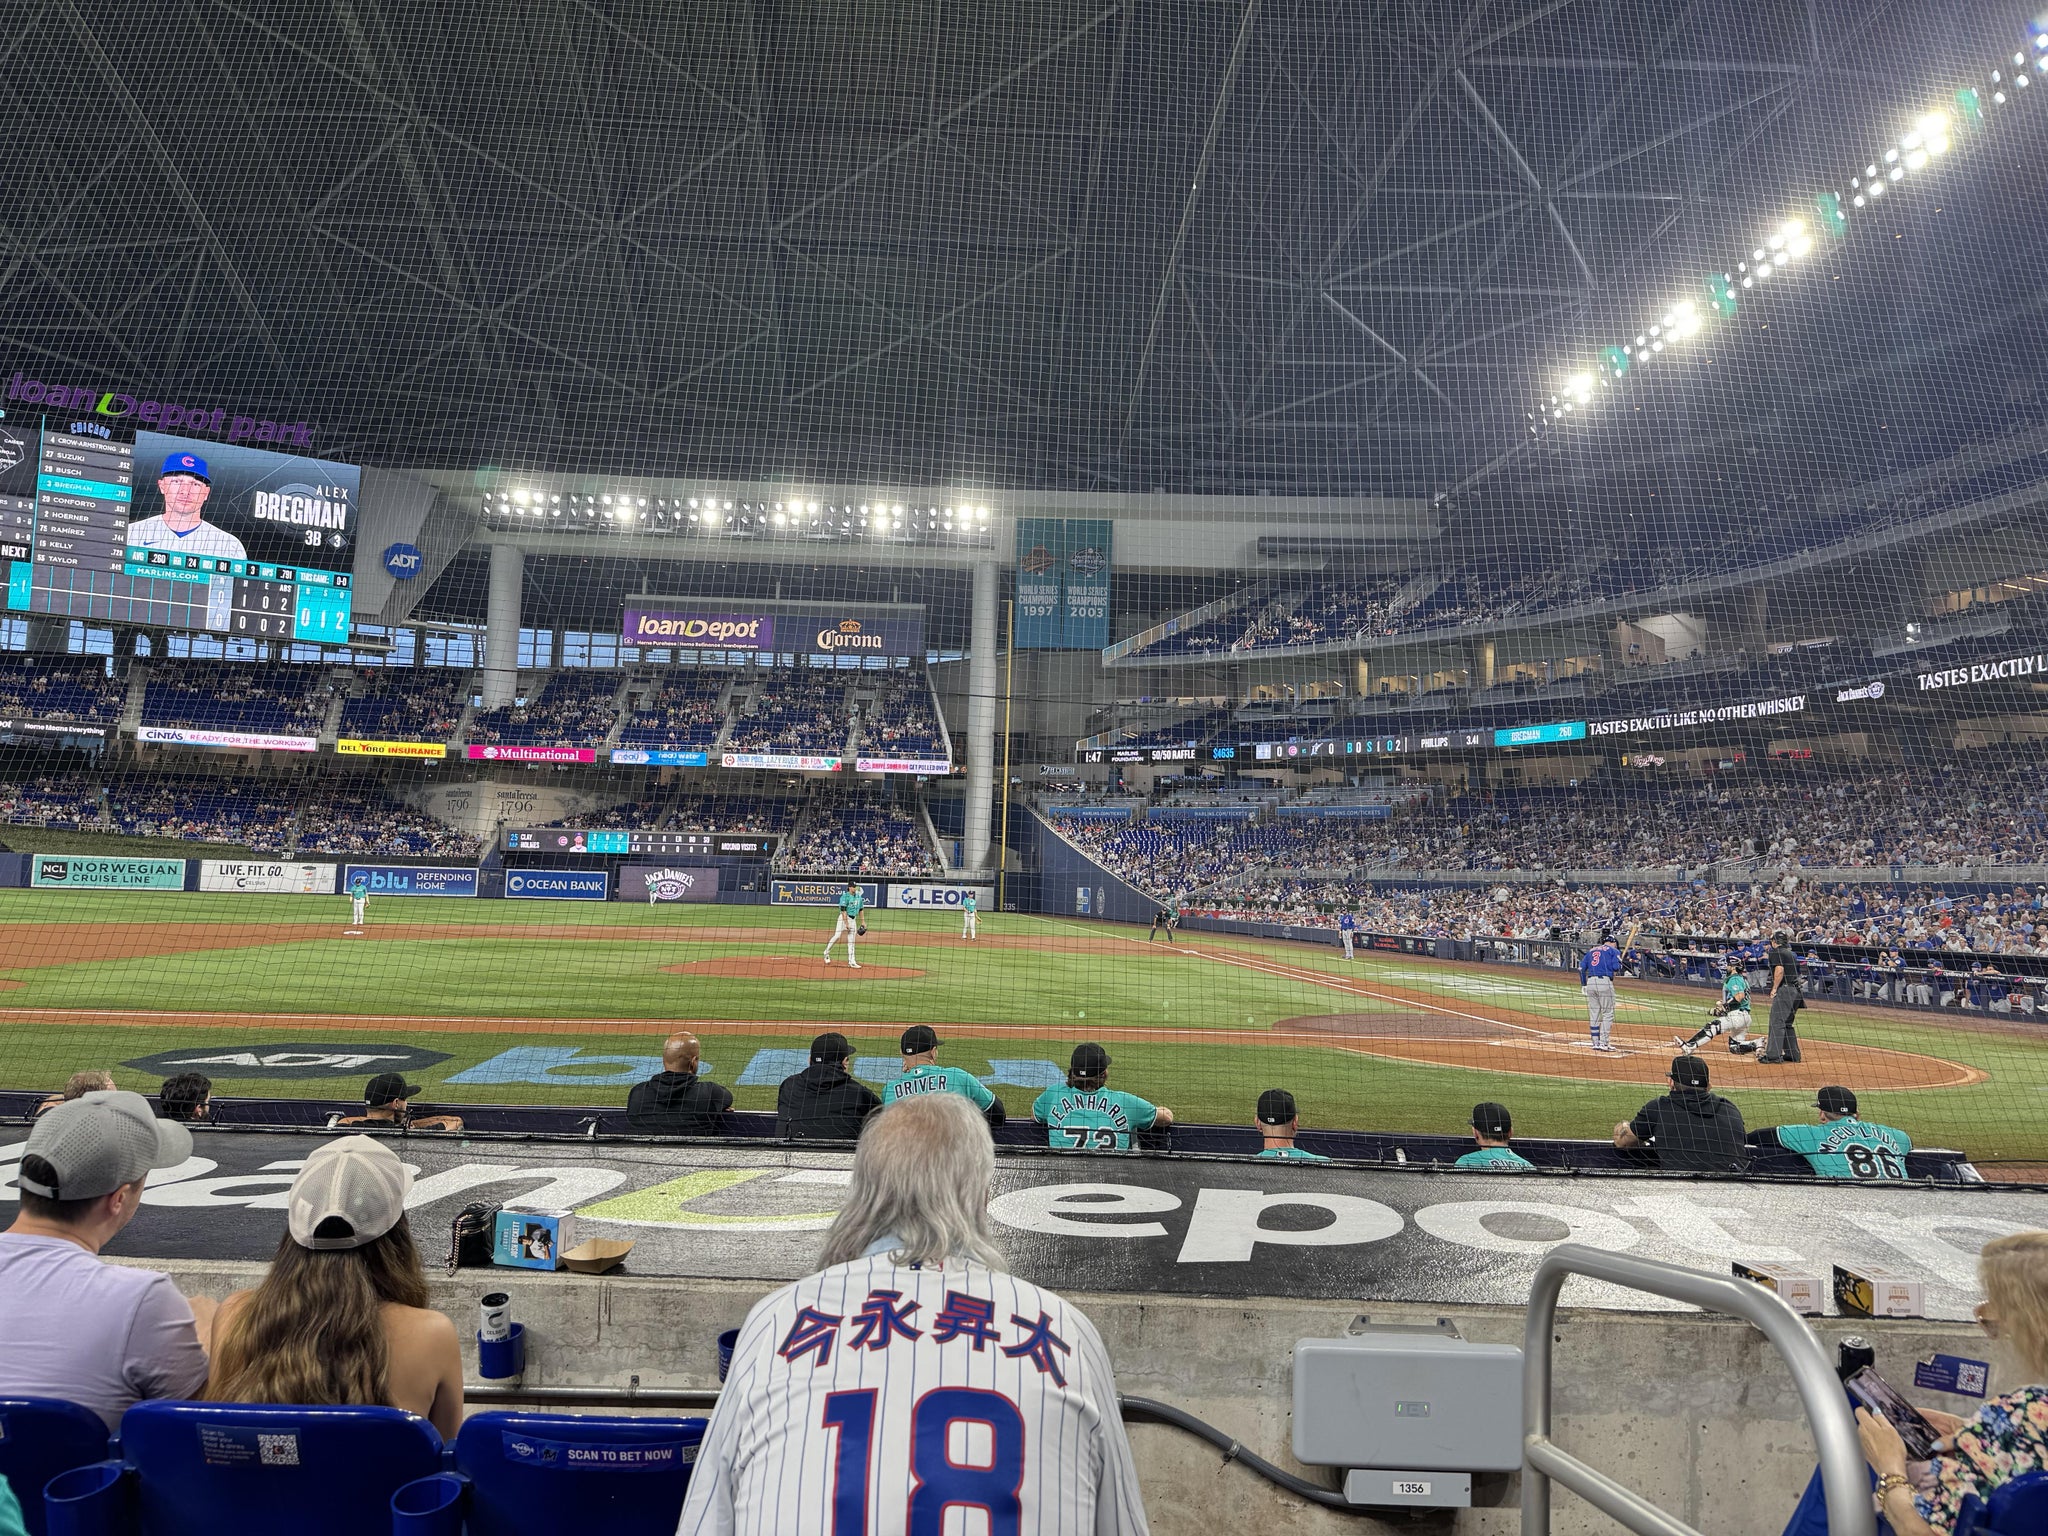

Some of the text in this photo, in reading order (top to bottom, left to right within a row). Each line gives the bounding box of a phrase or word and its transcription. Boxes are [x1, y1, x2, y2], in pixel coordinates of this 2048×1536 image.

[7, 372, 315, 448] loanDepot park
[71, 422, 111, 439] CHICAGO
[58, 438, 116, 452] CROW-ARMSTRONG
[57, 453, 85, 461] SUZUKI
[56, 466, 81, 475] BUSCH
[54, 482, 92, 491] BREGMAN
[316, 485, 348, 499] ALEX
[53, 497, 96, 508] CONFORTO
[52, 512, 89, 521] HOERNER
[254, 491, 346, 530] BREGMAN
[51, 527, 85, 536] RAMÍREZ
[305, 530, 341, 547] 3B 3
[2, 545, 27, 558] NEXT
[49, 556, 78, 564] TAYLOR
[132, 551, 144, 561] AVG
[152, 554, 166, 564] .260
[189, 558, 196, 567] 24
[220, 562, 227, 571] 81
[251, 566, 255, 574] 3
[389, 553, 419, 569] ADT
[137, 568, 198, 580] MARLINS.COM
[279, 584, 292, 592] ABS
[1019, 586, 1058, 595] WORLD SERIES
[1067, 586, 1107, 595] WORLD SERIES
[219, 591, 287, 611] 0 1 0 2
[1019, 595, 1058, 604] CHAMPIONS
[1067, 596, 1107, 606] CHAMPIONS
[1024, 606, 1053, 616] 1997
[1071, 608, 1103, 617] 2003
[216, 614, 285, 633] 0 0 0 2
[301, 608, 344, 630] 0 1 2
[638, 615, 759, 641] loanDepot
[817, 628, 883, 651] Corona
[1917, 657, 2035, 690] TASTES EXACTLY
[1589, 695, 1805, 736] TASTES EXACTLY LIKE NO OTHER WHISKEY
[69, 726, 104, 736] Everything
[190, 734, 219, 742] READY
[223, 736, 241, 744] FOR
[264, 738, 307, 747] WORKDAY
[1277, 746, 1282, 757] 0
[1329, 744, 1334, 754] 0
[1347, 743, 1352, 753] B
[1356, 742, 1361, 753] 0
[1367, 742, 1372, 752] S
[1395, 741, 1400, 751] 2
[1421, 737, 1448, 748] PHILLIPS
[1511, 730, 1540, 742] BREGMAN
[341, 744, 358, 752] DEL
[388, 747, 443, 756] INSURANCE
[500, 748, 580, 760] Multinational
[1085, 748, 1234, 762] 1:47 50/50 RAFFLE $4635
[448, 800, 469, 813] 1796
[500, 800, 532, 815] 1796
[763, 842, 768, 850] 4
[43, 865, 66, 873] NCL
[73, 862, 177, 875] NORWEGIAN
[220, 864, 284, 877] LIVE. FIT. GO.
[72, 874, 150, 883] CRUISE LINE
[371, 871, 408, 888] blu
[416, 872, 472, 882] DEFENDING
[645, 868, 694, 888] JACK DANIEL'S
[416, 881, 446, 890] HOME
[526, 879, 603, 891] OCEAN BANK
[1591, 951, 1601, 966] 3
[166, 1053, 412, 1069] ADT
[894, 1074, 947, 1099] DRIVER
[1844, 1142, 1902, 1179] 86
[778, 1289, 1071, 1388] 今永昇太
[568, 1449, 672, 1461] SCAN TO BET NOW
[822, 1386, 1025, 1536] 18
[1399, 1483, 1424, 1493] 1356
